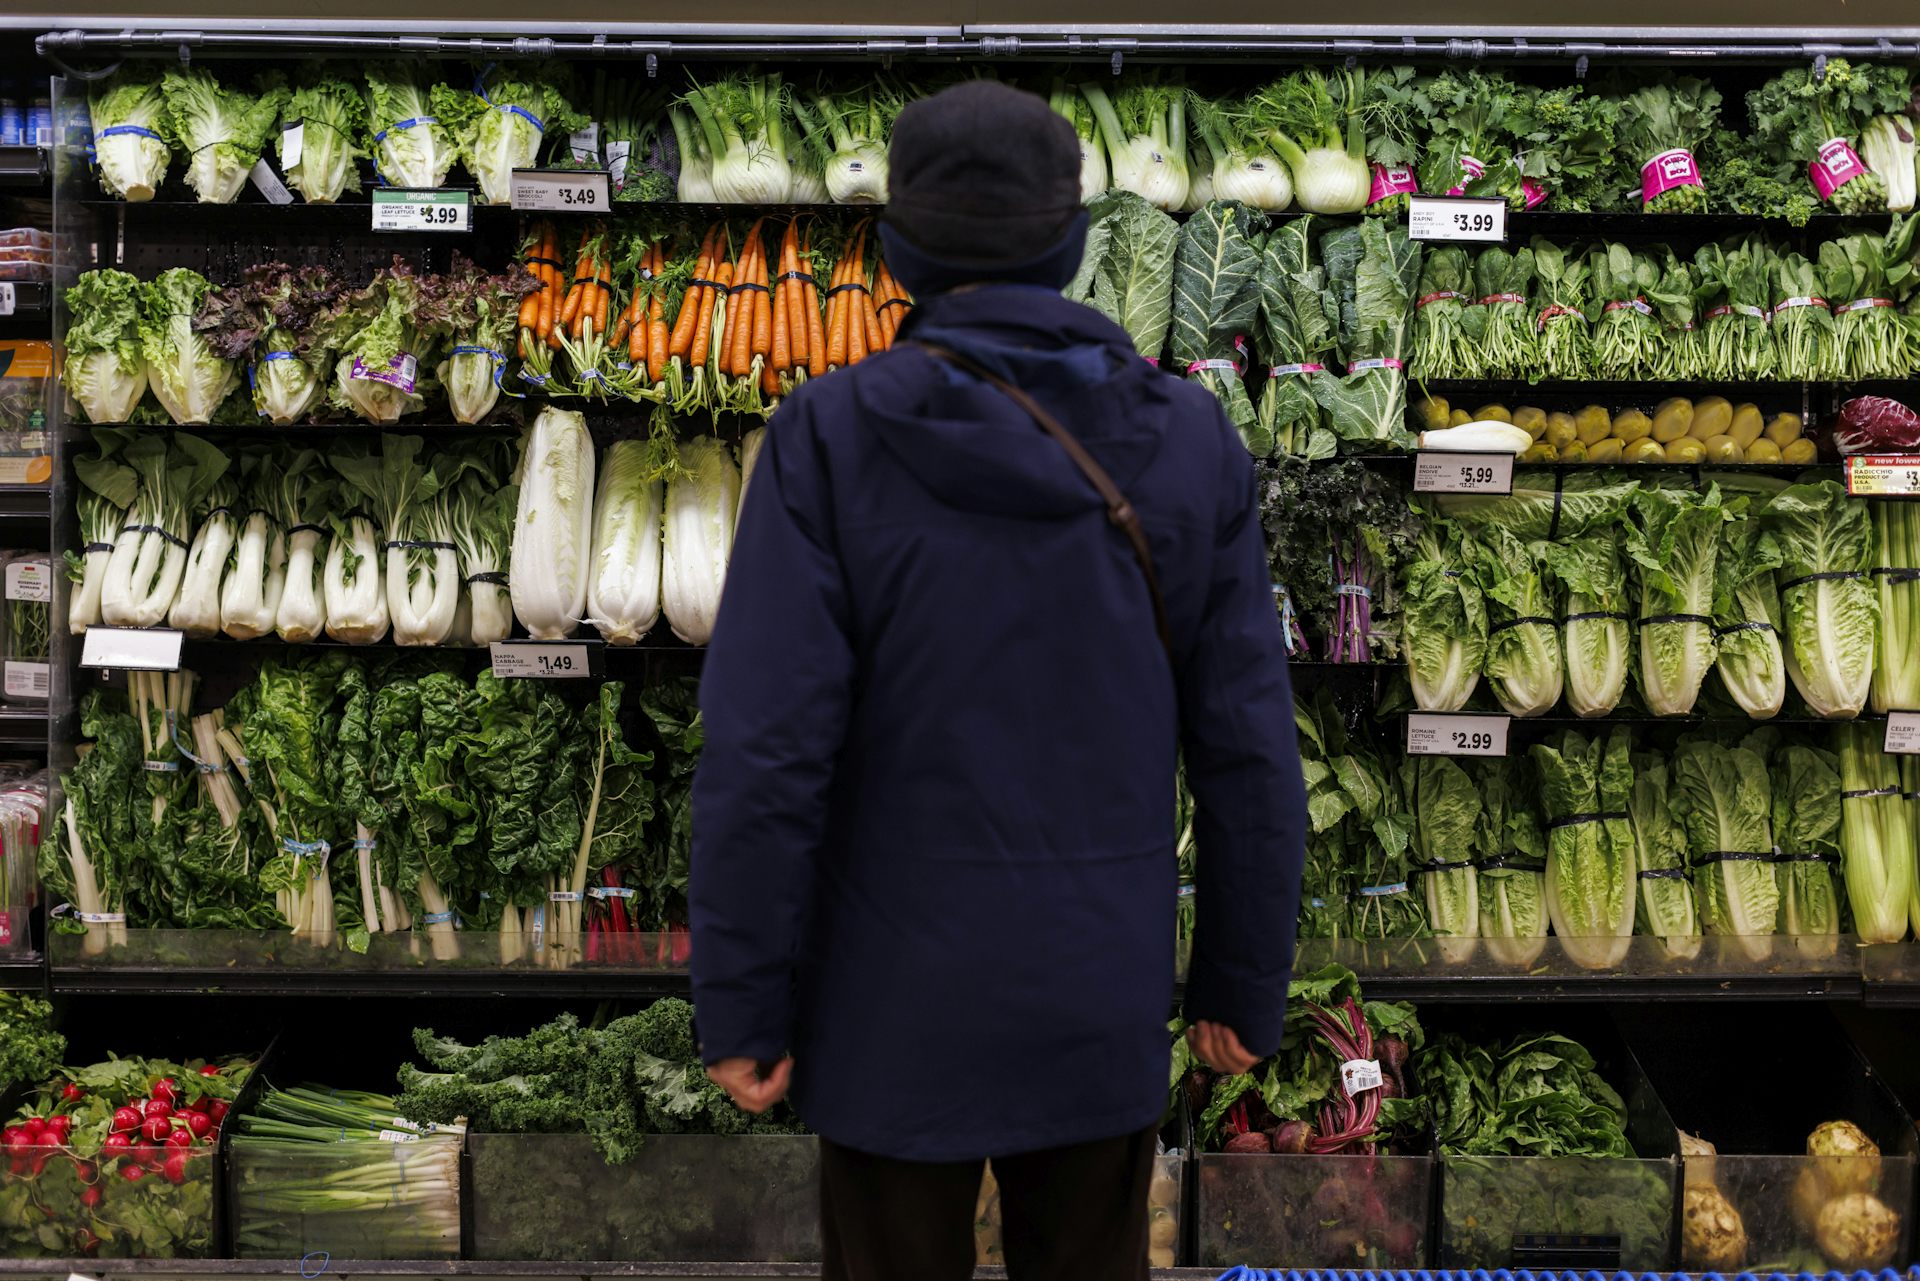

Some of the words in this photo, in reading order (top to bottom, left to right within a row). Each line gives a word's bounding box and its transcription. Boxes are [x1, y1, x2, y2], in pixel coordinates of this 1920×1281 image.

[1670, 168, 1687, 176] BOY
[1833, 160, 1848, 172] BOY
[406, 192, 436, 200] ORGANIC
[558, 189, 595, 204] $3.49
[1454, 214, 1493, 232] $3.99
[1460, 467, 1493, 483] $5.99
[538, 656, 571, 670] $1.49
[1452, 732, 1491, 749] $2.99
